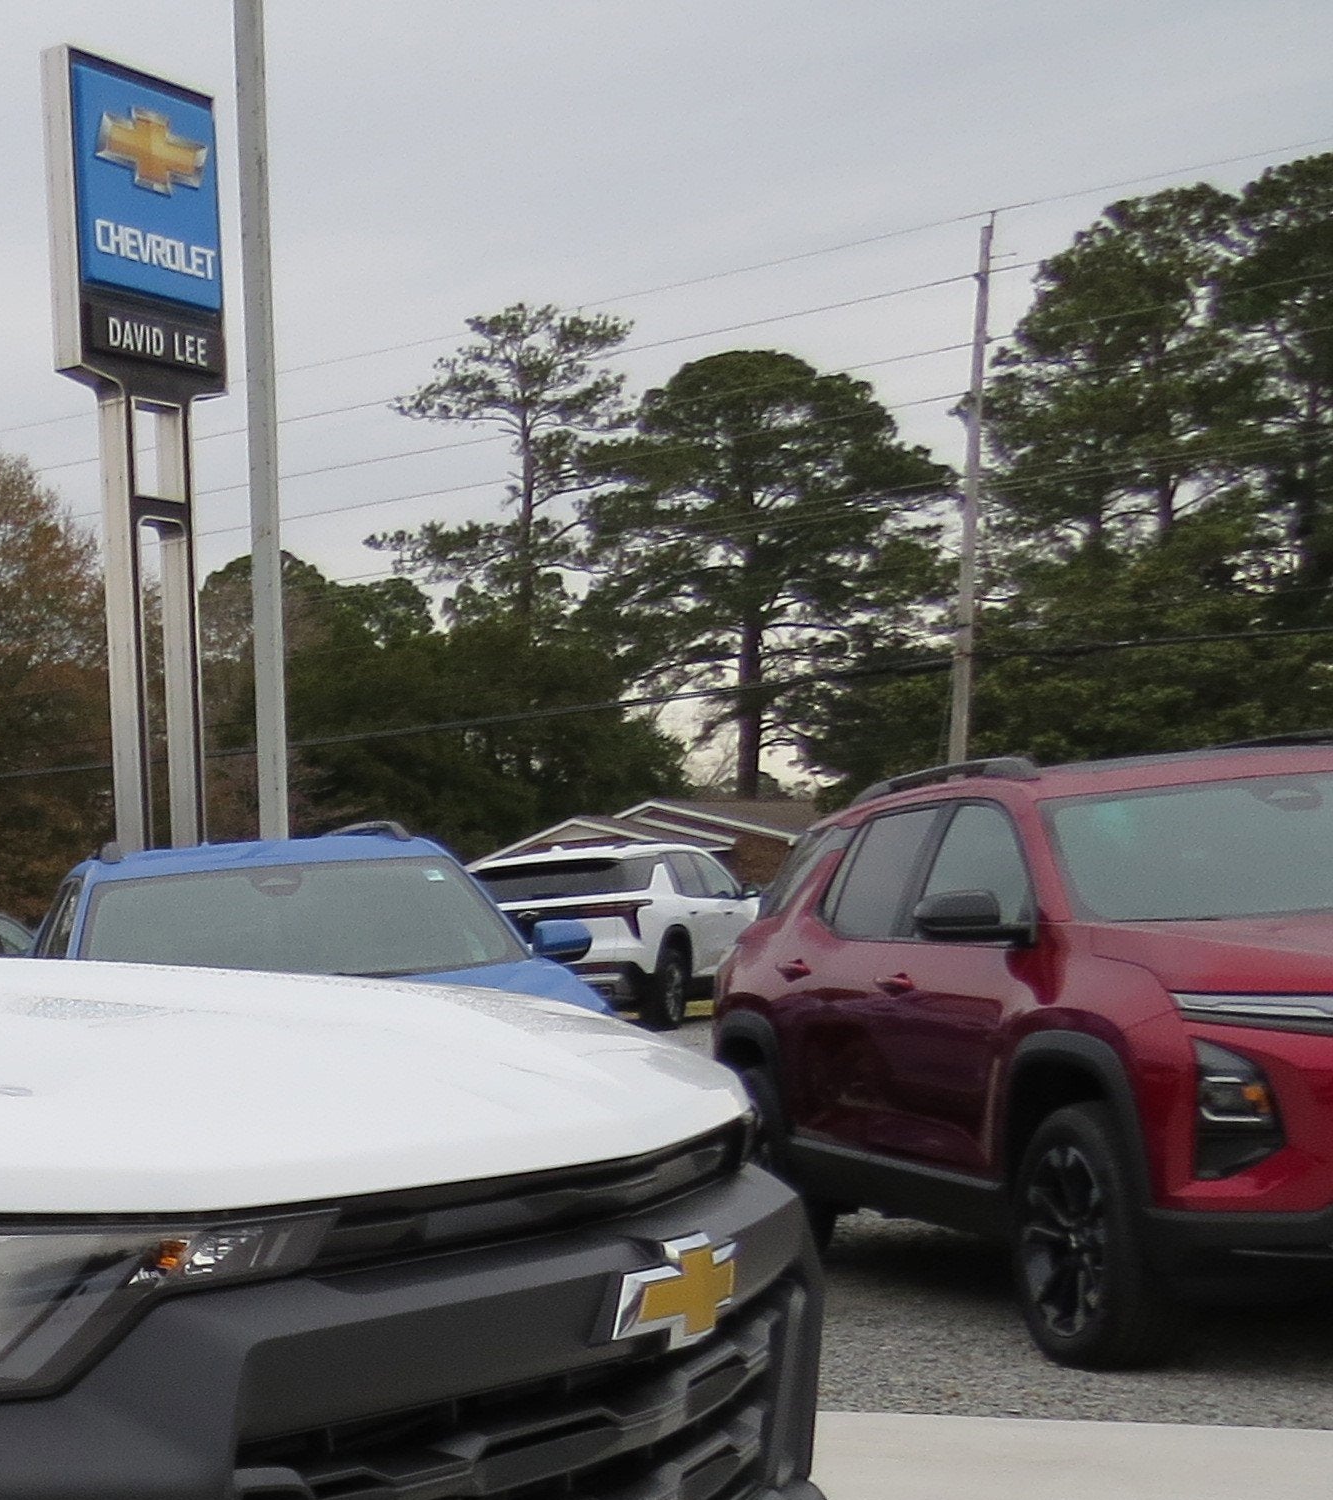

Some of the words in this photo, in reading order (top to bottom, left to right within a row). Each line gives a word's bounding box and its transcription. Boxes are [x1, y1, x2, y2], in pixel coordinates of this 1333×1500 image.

[95, 218, 215, 280] CHEVROLET
[107, 316, 164, 357] DAVID
[173, 331, 208, 368] LEE
